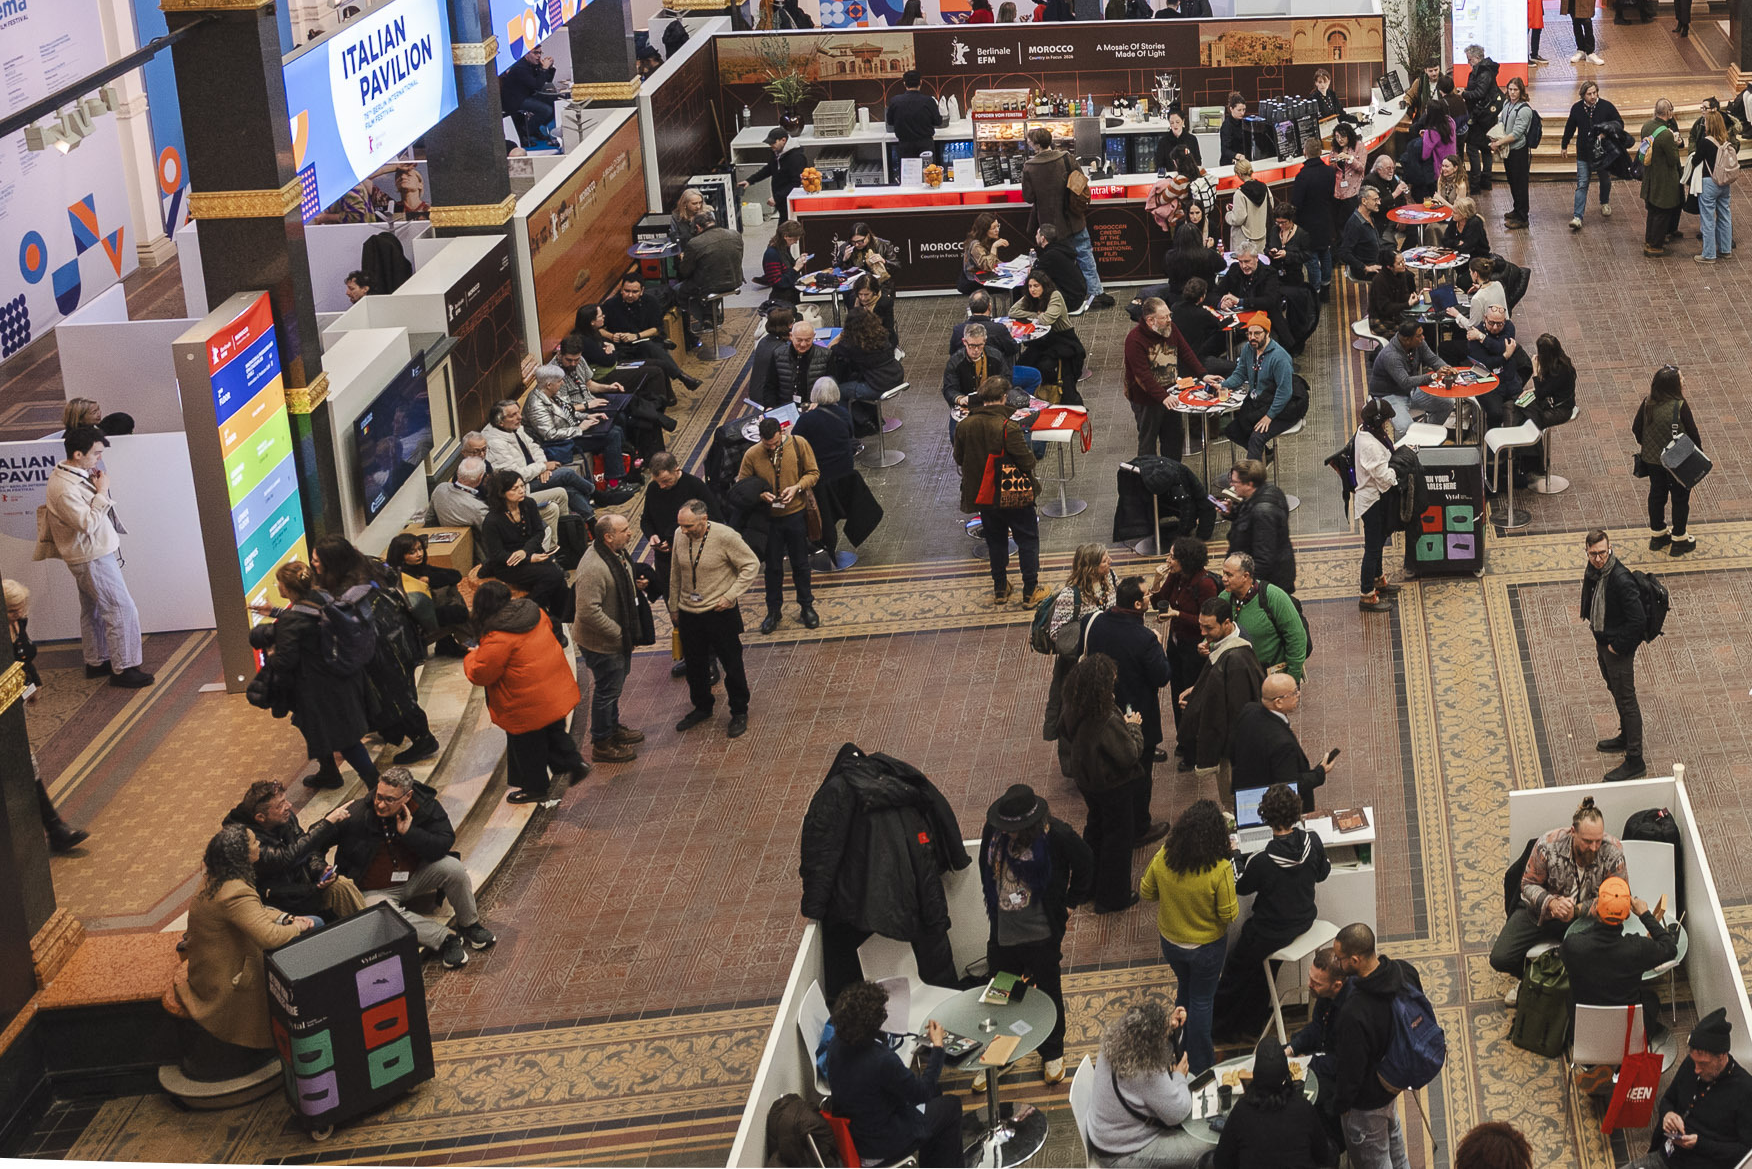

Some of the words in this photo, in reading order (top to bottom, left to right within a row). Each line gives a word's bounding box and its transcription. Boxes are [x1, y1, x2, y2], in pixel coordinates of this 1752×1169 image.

[341, 15, 406, 80] ITALIAN
[1029, 45, 1074, 54] MOROCCO
[1115, 50, 1135, 58] Made
[1137, 50, 1146, 58] Of
[977, 56, 996, 64] EFM
[360, 35, 433, 107] PAVILION
[1111, 186, 1124, 194] Bar
[920, 242, 964, 252] MOROCC
[1435, 475, 1449, 483] YOUR
[1443, 482, 1456, 490] HERE
[1445, 493, 1460, 501] Vytal
